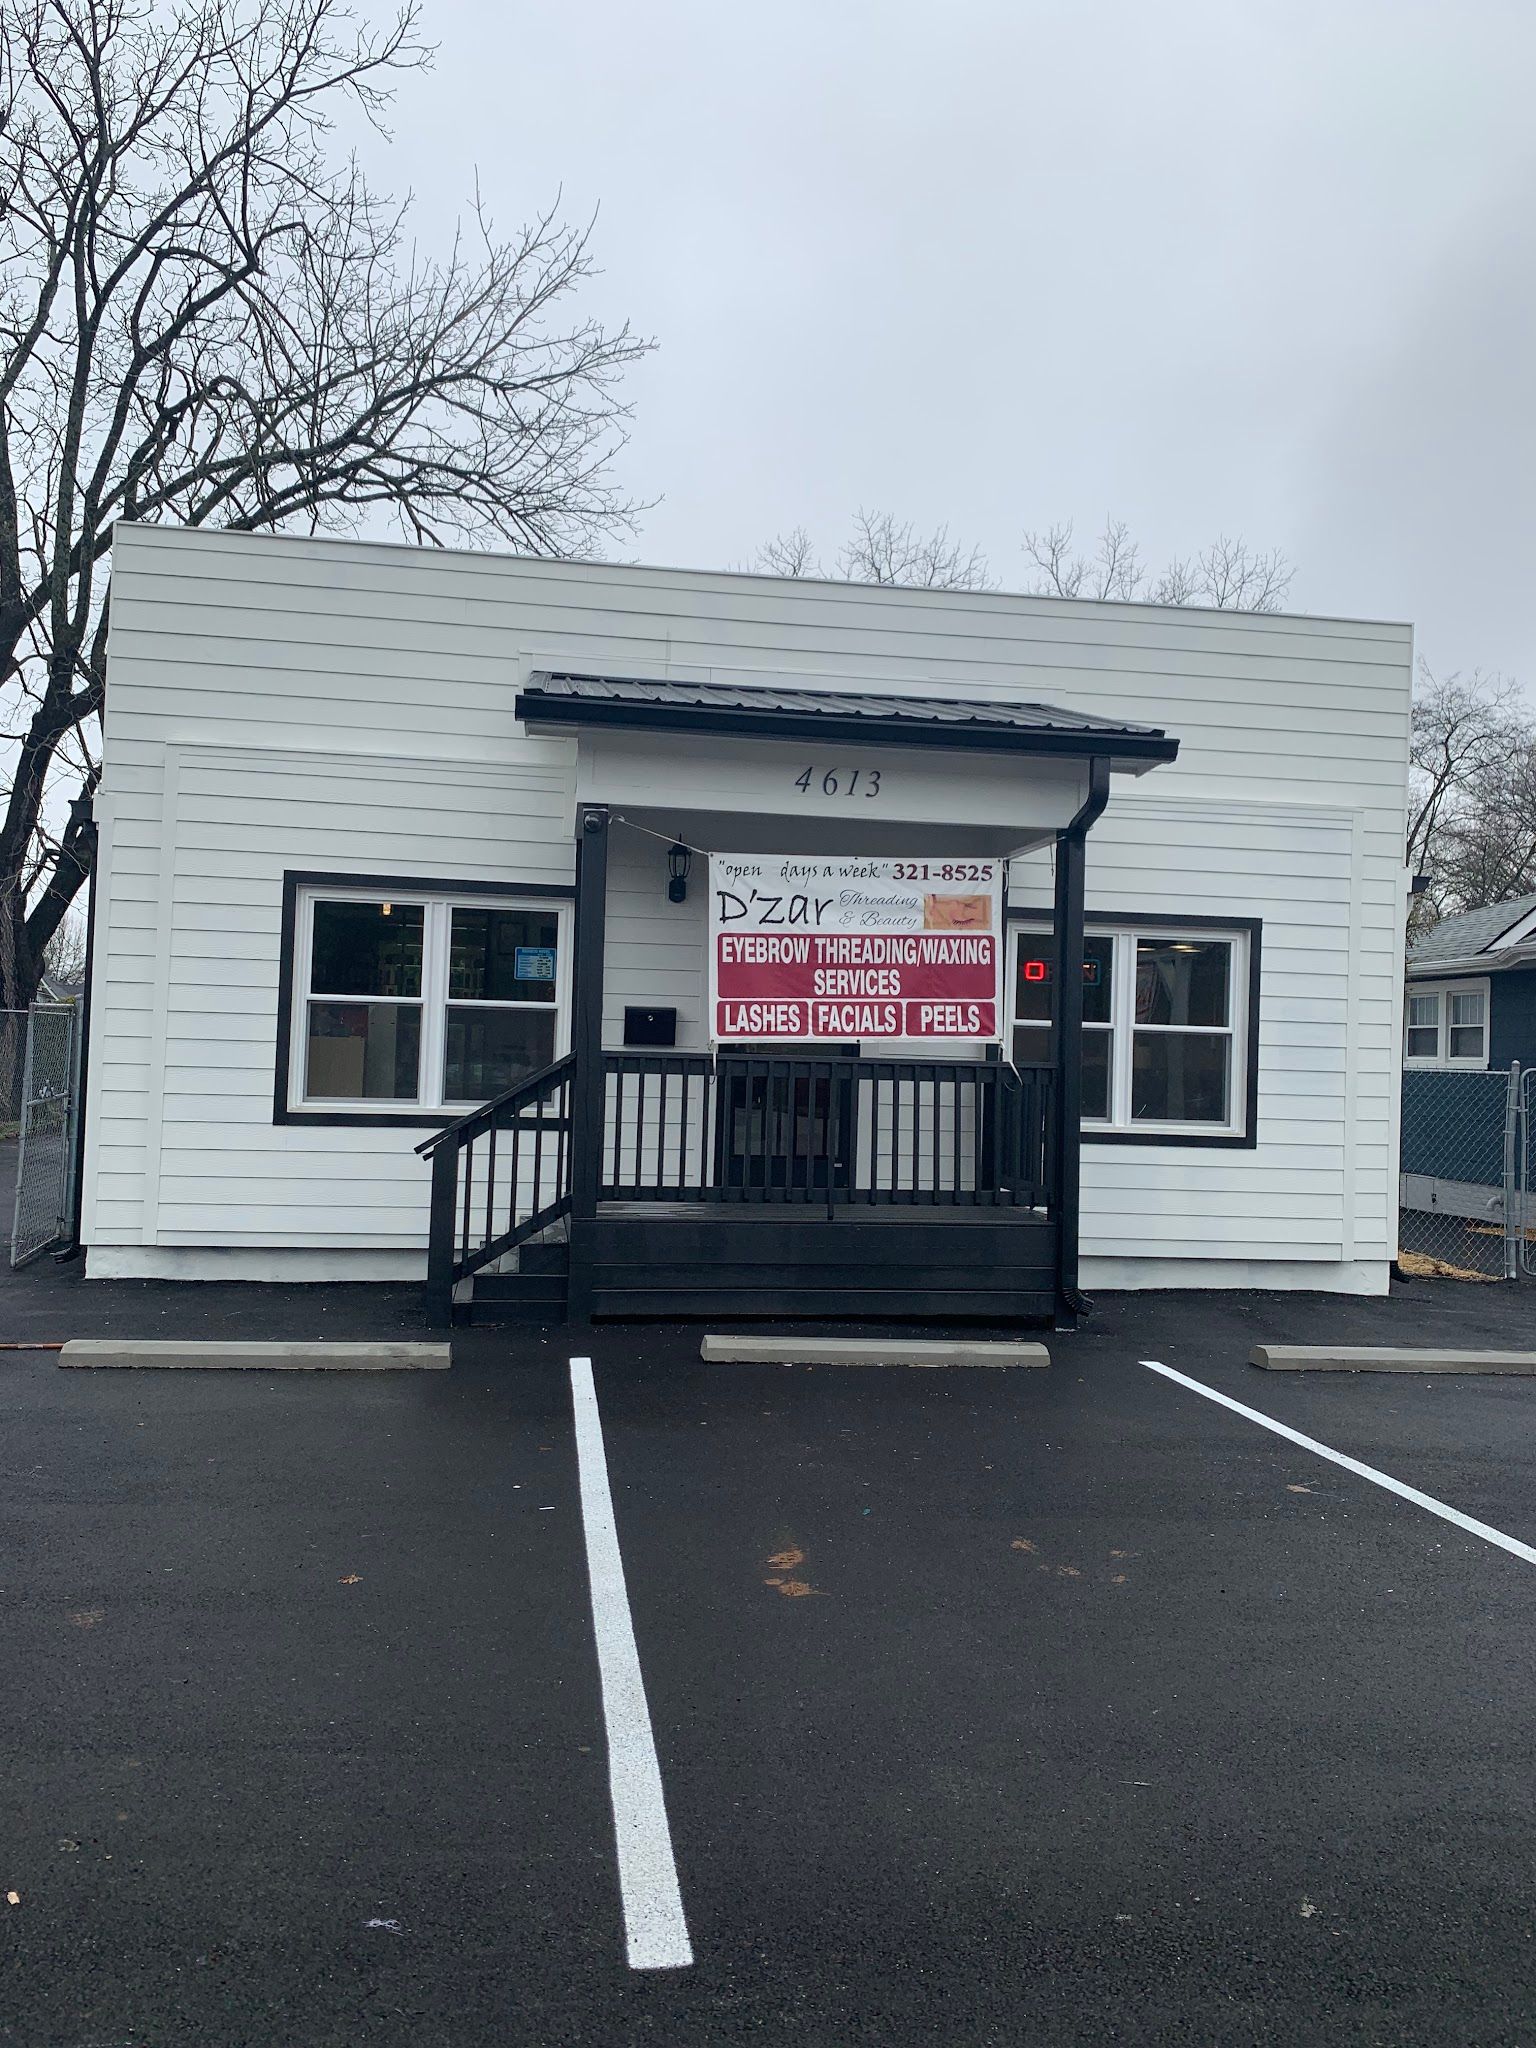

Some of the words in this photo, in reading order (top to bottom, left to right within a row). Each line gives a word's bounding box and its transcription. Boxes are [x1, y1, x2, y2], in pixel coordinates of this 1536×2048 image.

[795, 766, 881, 798] 4613
[719, 860, 762, 887] "open
[780, 861, 817, 888] days
[823, 866, 834, 877] a
[839, 862, 889, 879] week"
[893, 863, 993, 881] 321-8525
[717, 889, 834, 925] D'zar
[839, 889, 919, 909] Threading
[839, 911, 855, 928] &
[860, 911, 918, 929] Beauty
[722, 936, 810, 963] EYEBROW
[815, 937, 991, 967] THREADING/WAXING
[814, 969, 900, 995] SERVICES
[725, 1004, 801, 1032] LASHES
[818, 1004, 897, 1032] FACIALS
[921, 1004, 980, 1032] PEELS
